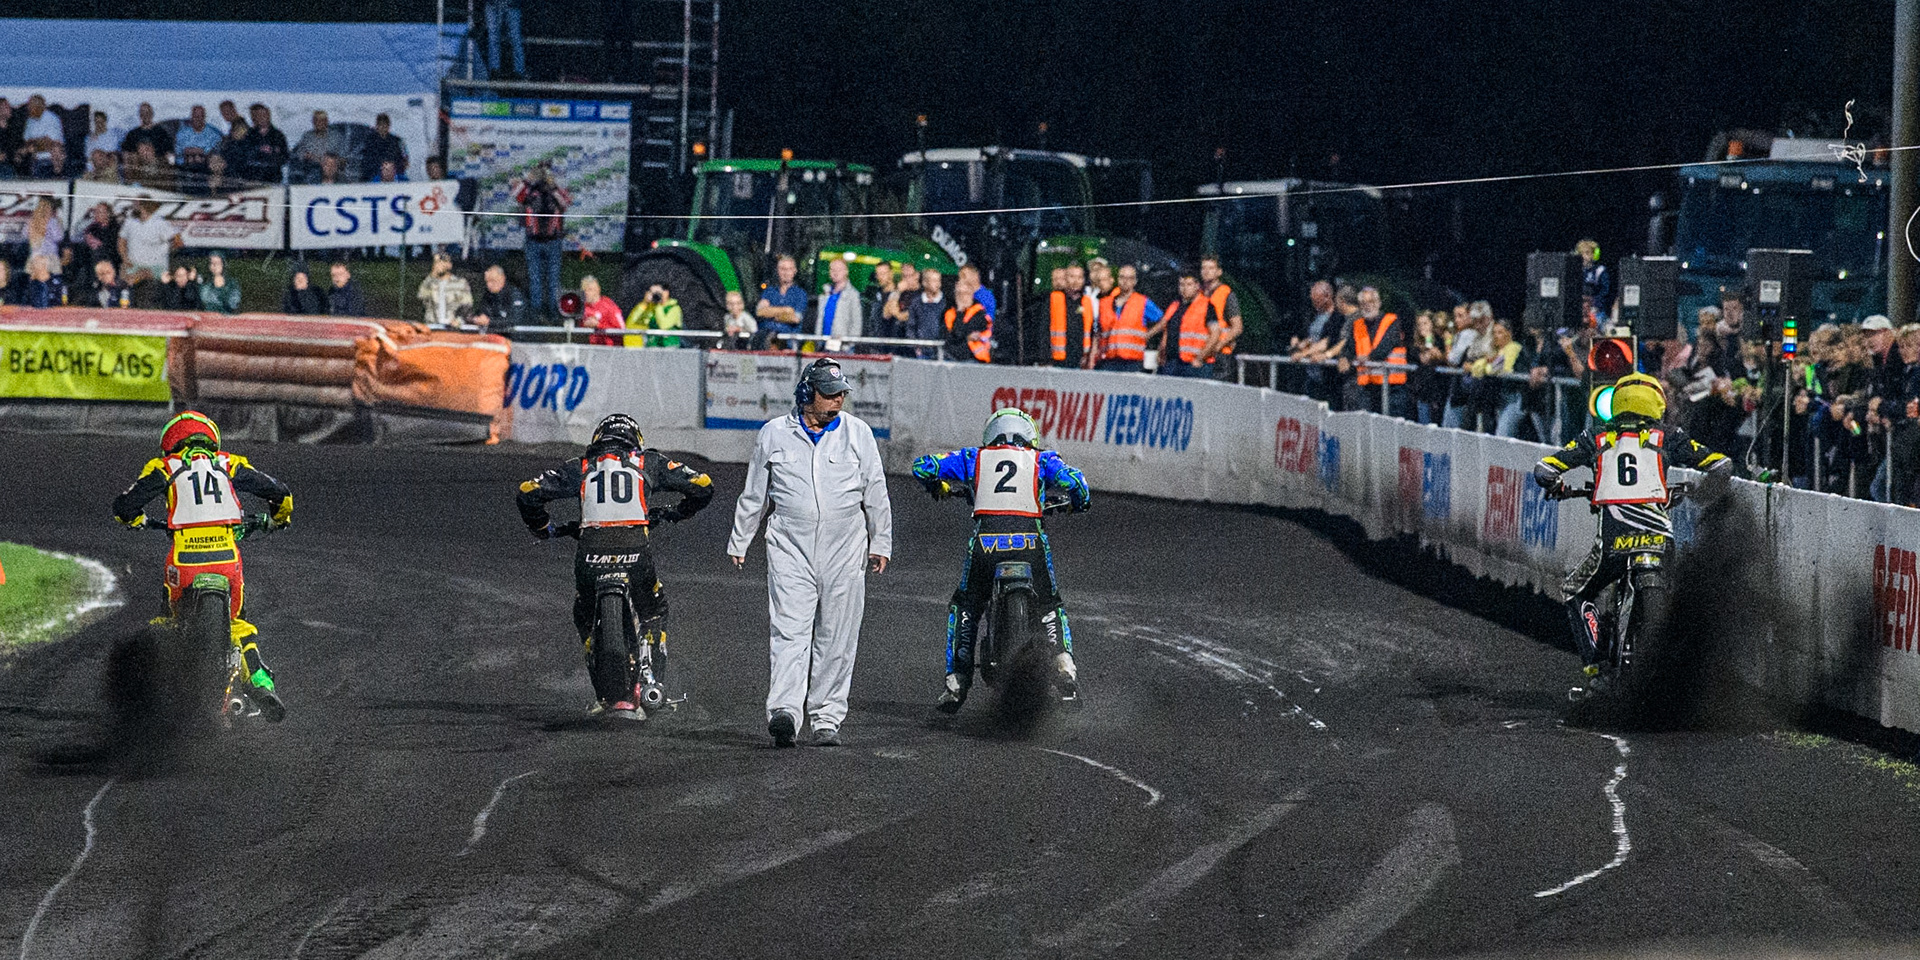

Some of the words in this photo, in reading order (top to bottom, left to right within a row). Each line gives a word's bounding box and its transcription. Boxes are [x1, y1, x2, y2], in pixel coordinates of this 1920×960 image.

[306, 195, 413, 236] CSTS
[10, 348, 154, 378] BEACHFLAGS
[1105, 393, 1193, 451] VEENOORD
[994, 460, 1017, 493] 2
[1617, 453, 1638, 486] 6
[188, 471, 222, 505] 14
[590, 470, 633, 504] 10
[978, 532, 1039, 554] WEST
